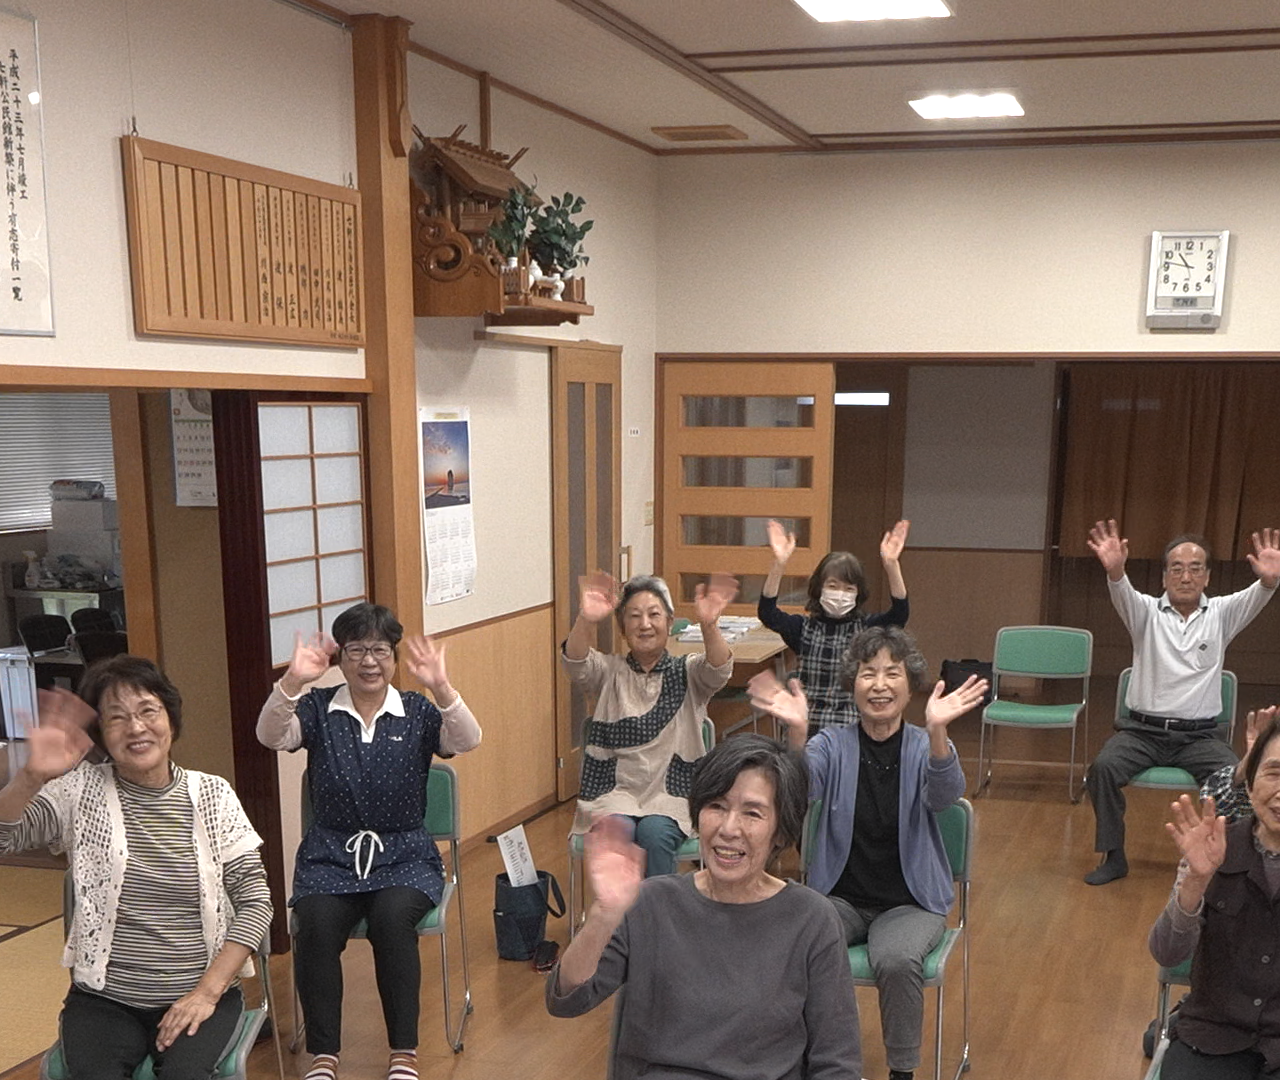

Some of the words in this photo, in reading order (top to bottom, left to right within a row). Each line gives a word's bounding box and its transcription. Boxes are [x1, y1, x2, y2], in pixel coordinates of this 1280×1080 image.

[1174, 241, 1180, 250] 11
[1186, 241, 1193, 250] 12
[1200, 241, 1204, 250] 1
[1165, 250, 1173, 259] 10
[1207, 249, 1213, 259] 2
[1163, 261, 1169, 271] 9
[1207, 262, 1213, 271] 3
[1163, 274, 1169, 284] 8
[1204, 274, 1210, 283] 4
[1172, 282, 1178, 291] 7
[1182, 282, 1189, 292] 6
[1195, 282, 1201, 291] 5
